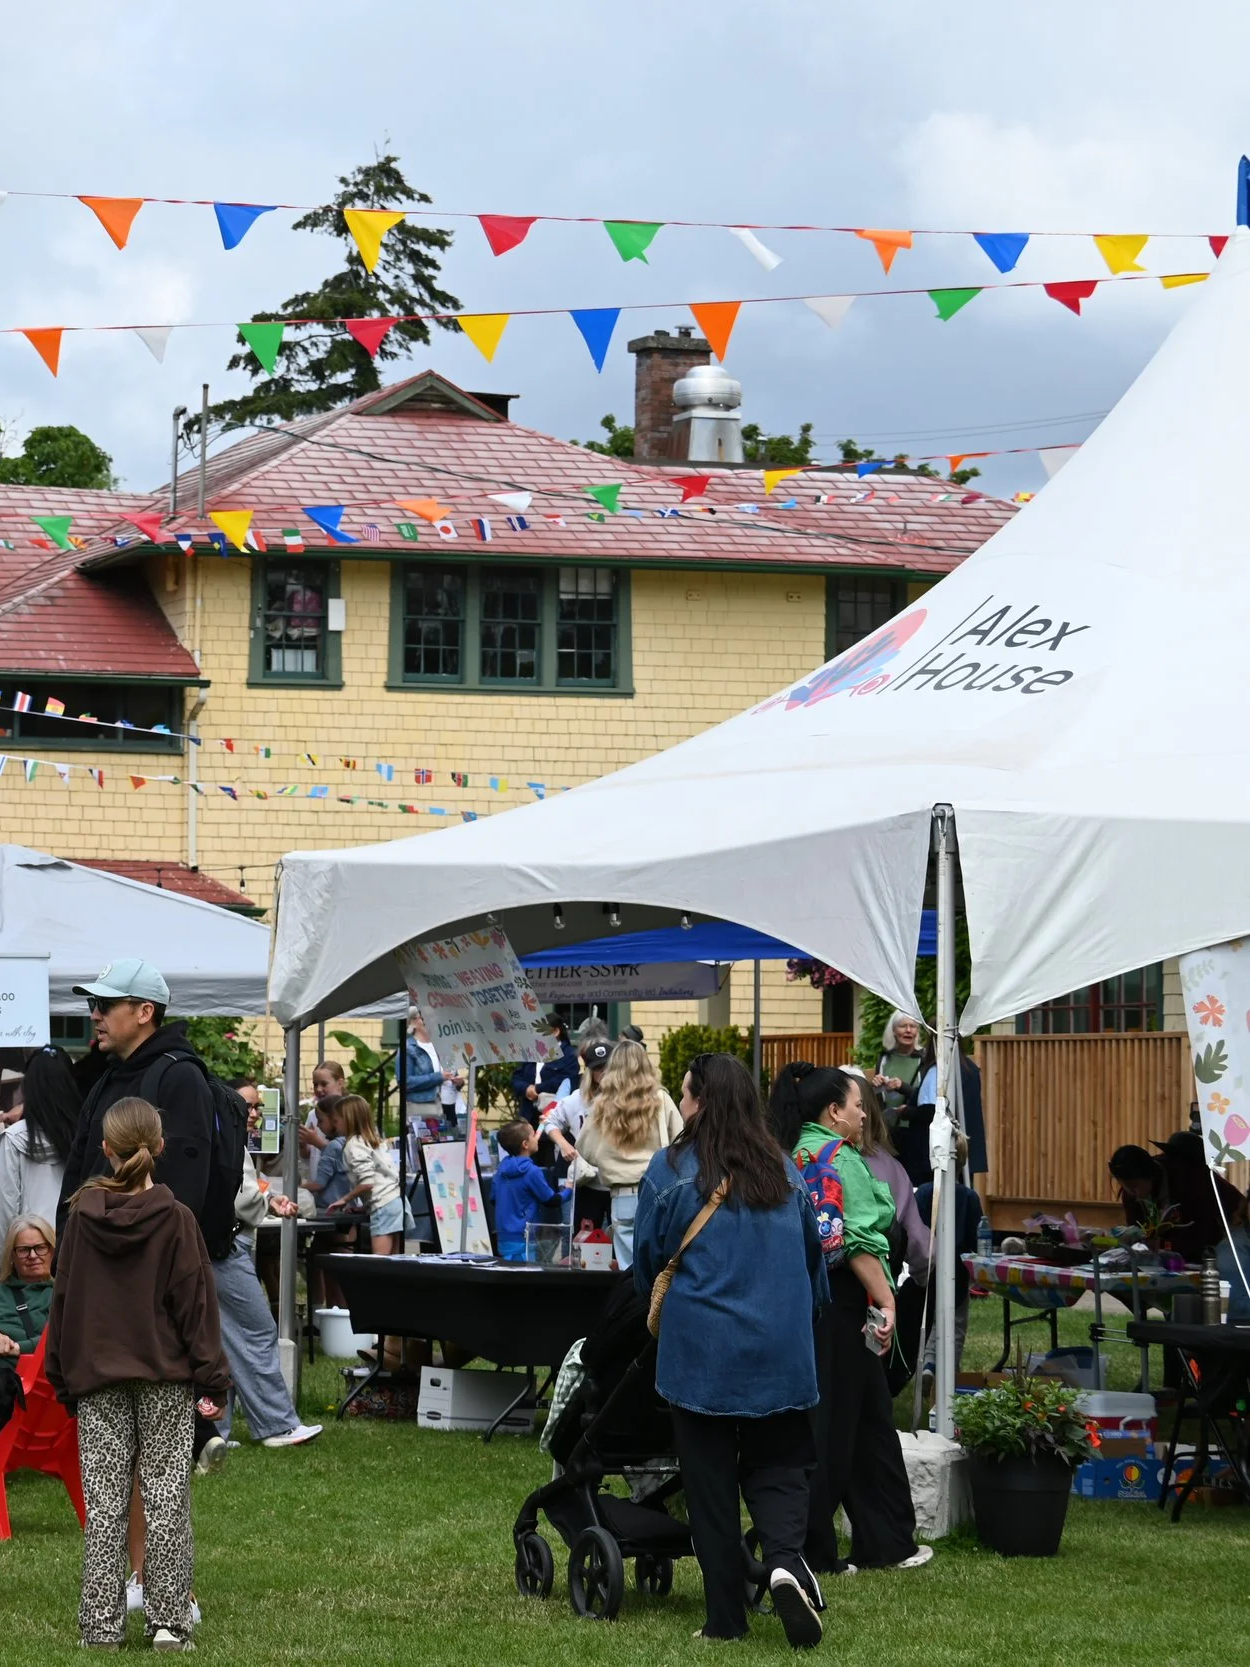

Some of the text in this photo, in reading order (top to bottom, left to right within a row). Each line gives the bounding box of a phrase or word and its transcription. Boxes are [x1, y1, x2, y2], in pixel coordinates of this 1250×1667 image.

[949, 604, 1092, 652] Alex
[893, 652, 1075, 695] House
[454, 962, 504, 988] WEAVING
[525, 963, 640, 981] ETHER-SSWR
[438, 1019, 463, 1038] Join
